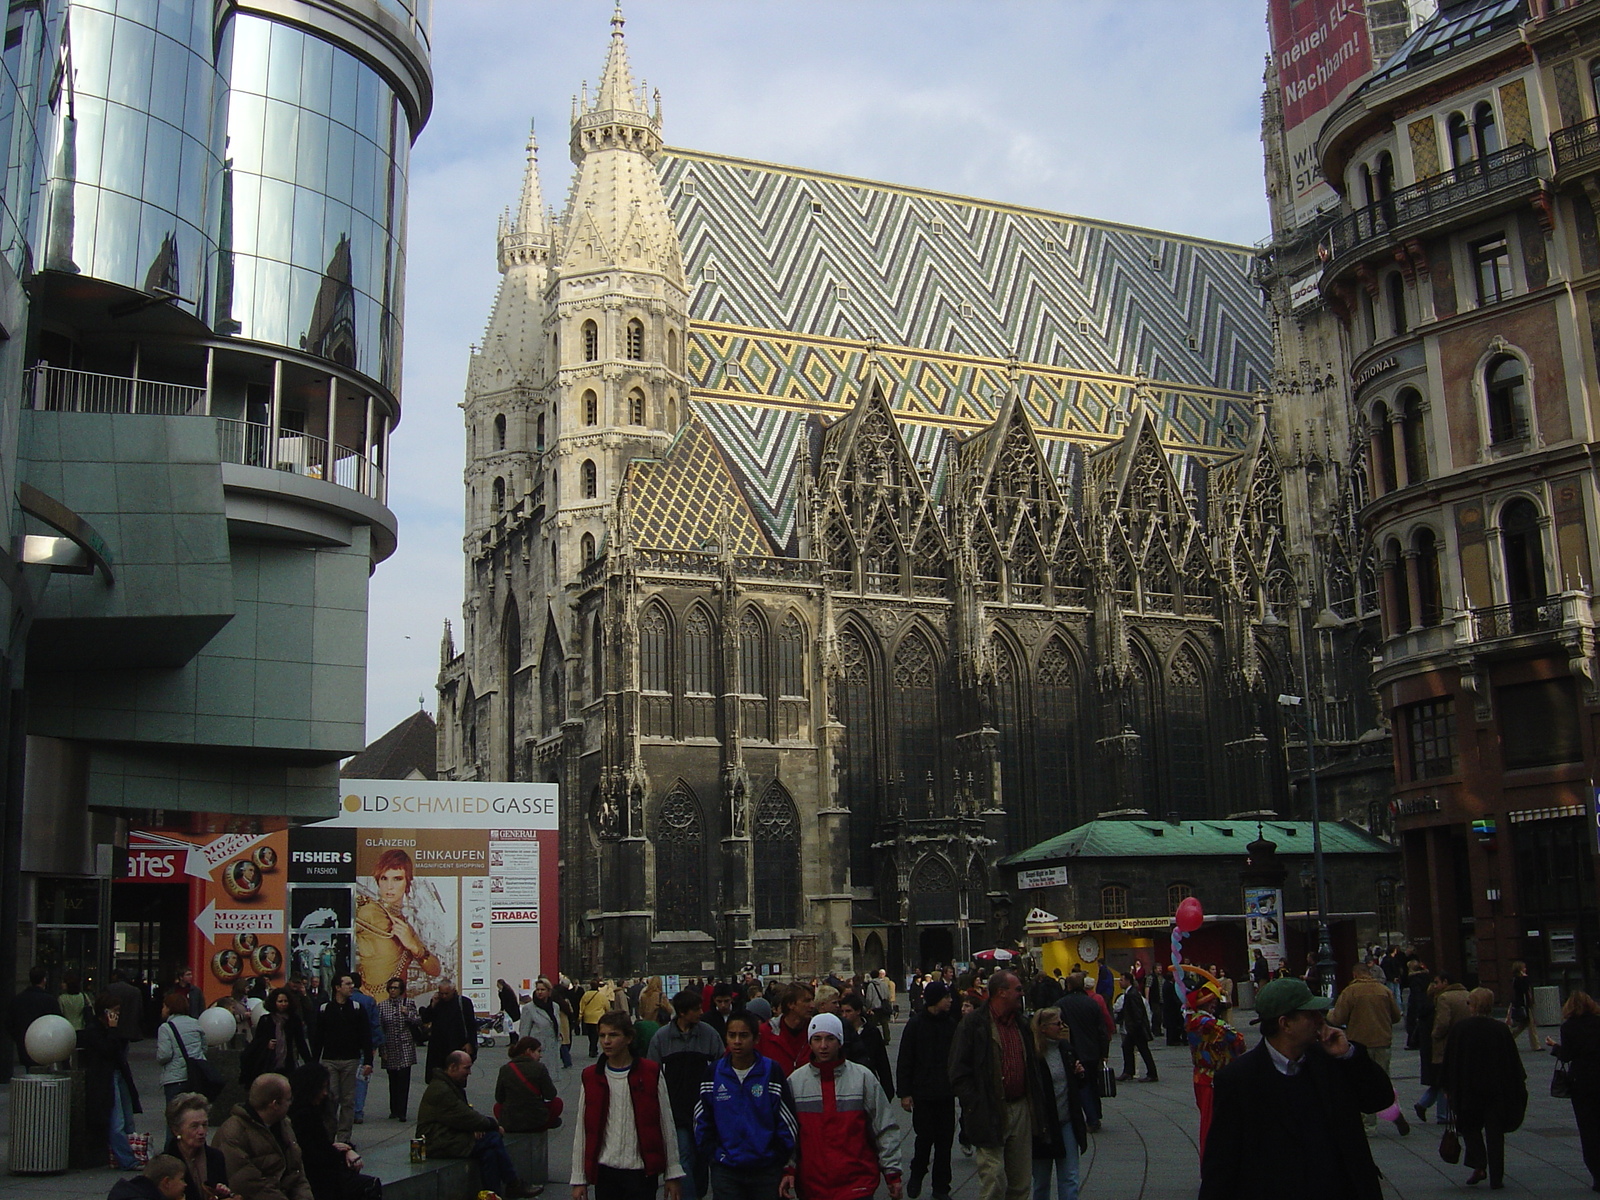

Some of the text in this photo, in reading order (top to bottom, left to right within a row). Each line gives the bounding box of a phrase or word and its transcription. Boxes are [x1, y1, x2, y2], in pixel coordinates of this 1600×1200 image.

[1281, 23, 1328, 70] neuen
[1285, 31, 1360, 107] Nachbarn!
[500, 830, 537, 838] GENERALI
[365, 838, 417, 847] GLÄNZEND
[415, 850, 485, 860] EINKAUFEN
[306, 867, 338, 875] IN FASHION
[214, 912, 274, 921] Mozart
[491, 911, 538, 920] STRABAG
[214, 921, 274, 931] kugeln
[1062, 922, 1088, 931] Spende
[1122, 918, 1169, 928] Stephansdom
